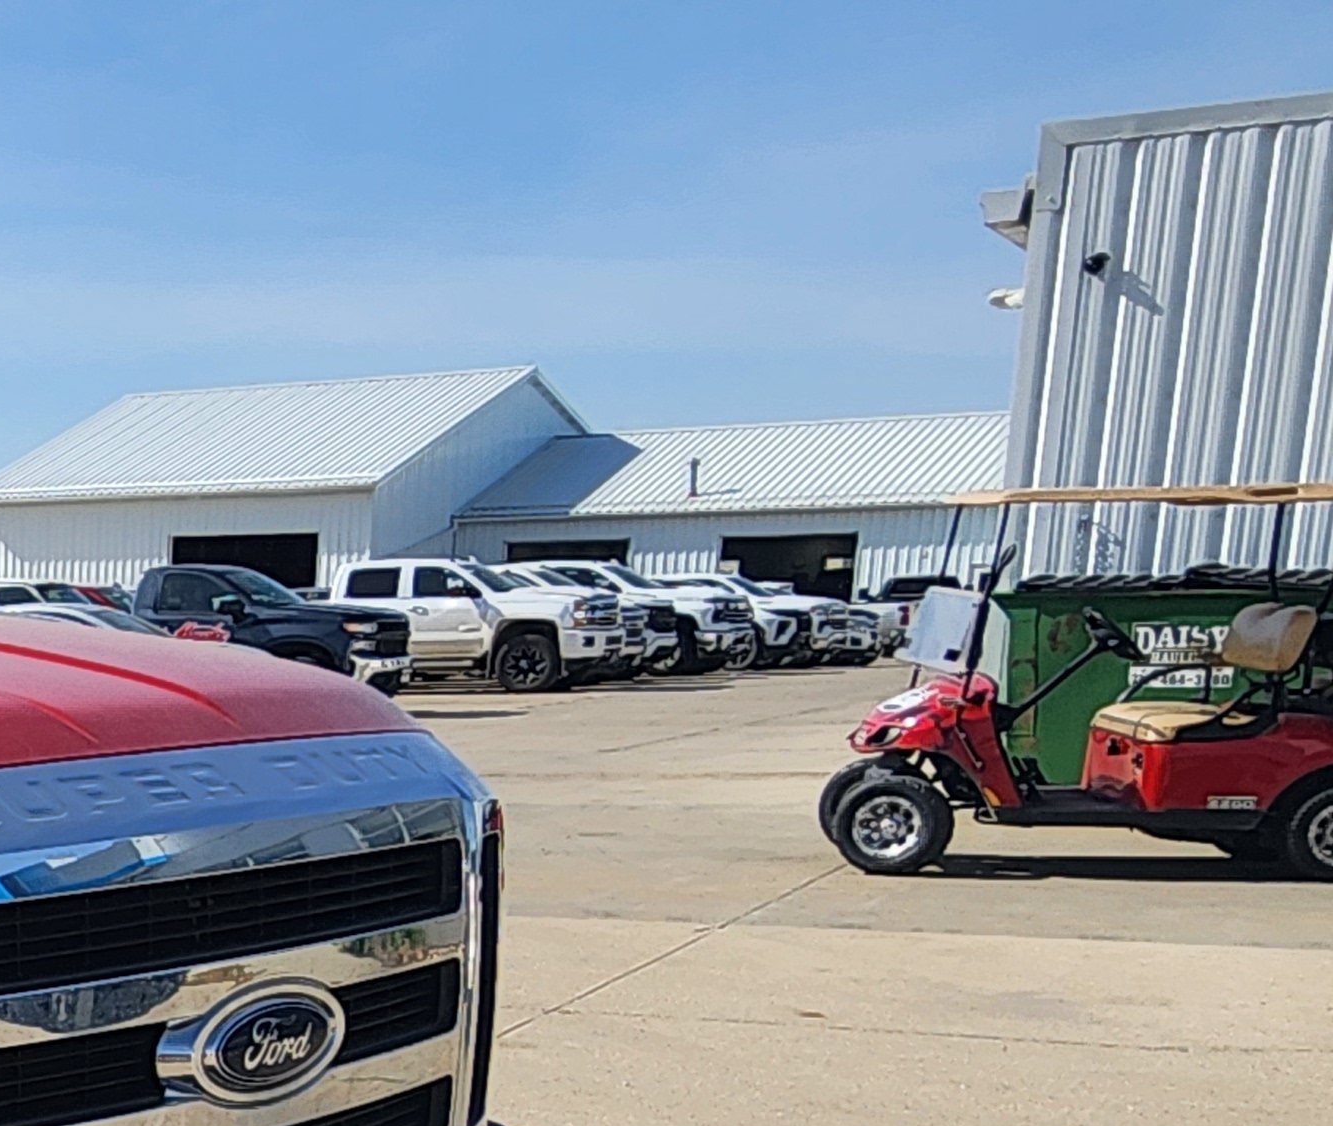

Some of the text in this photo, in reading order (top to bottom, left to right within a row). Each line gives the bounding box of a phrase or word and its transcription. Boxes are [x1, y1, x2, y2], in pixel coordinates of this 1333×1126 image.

[1135, 624, 1230, 655] DAISY
[262, 743, 430, 792] DUTY
[244, 1013, 314, 1071] Ford
